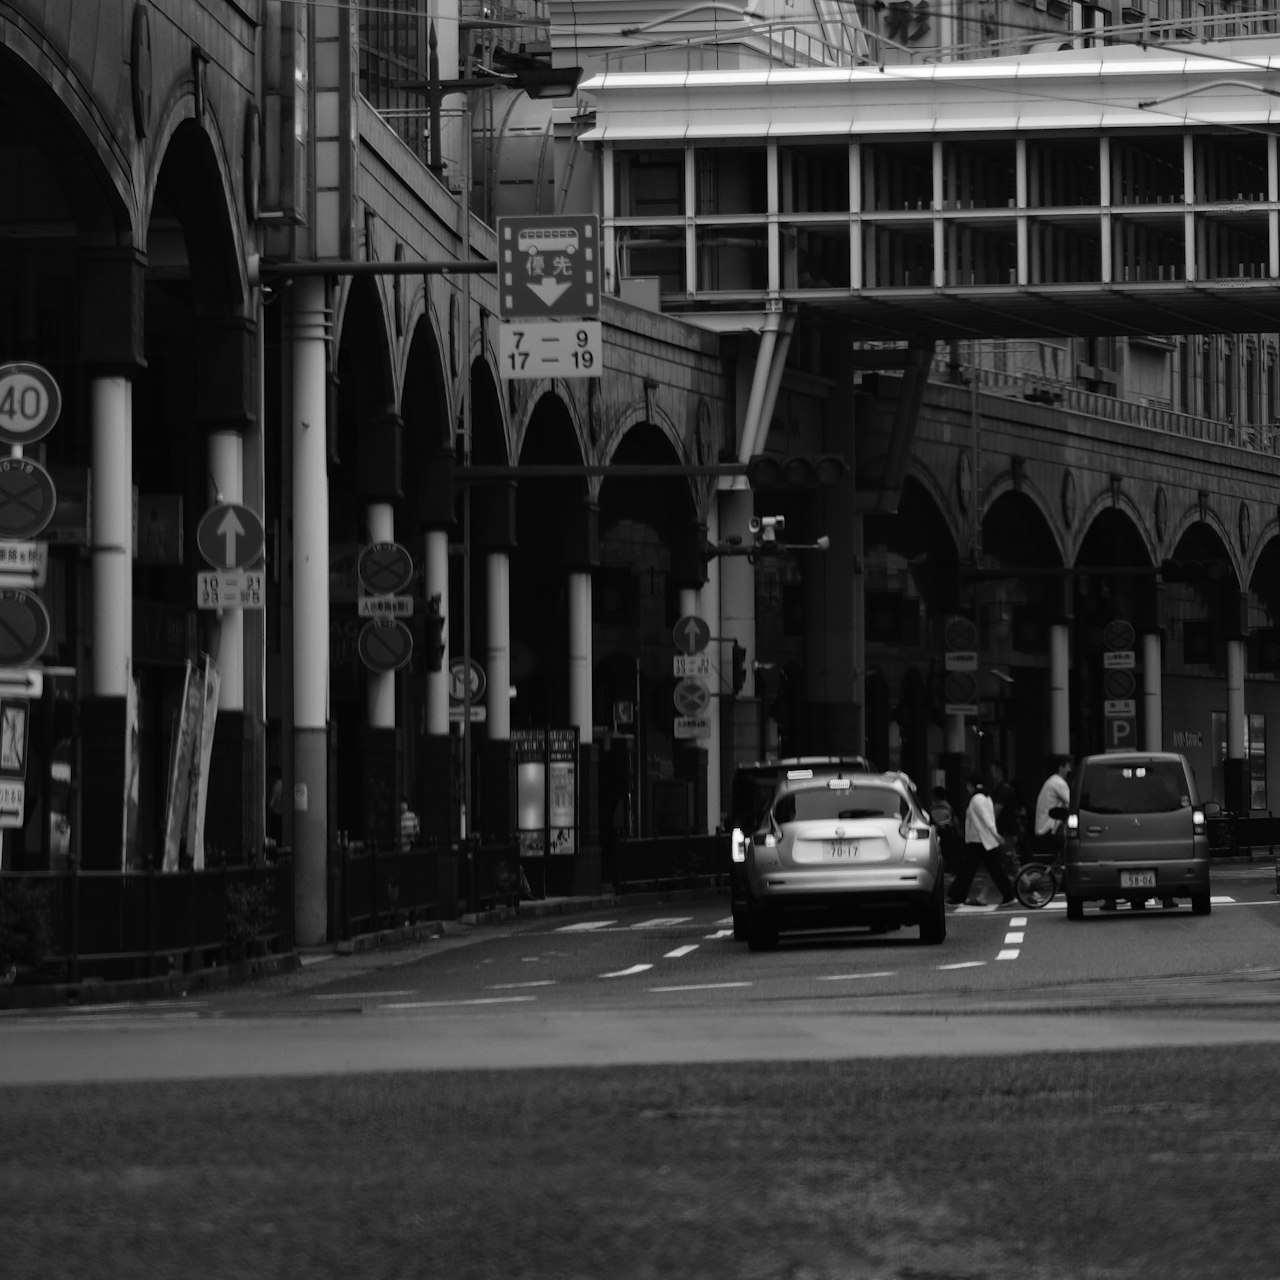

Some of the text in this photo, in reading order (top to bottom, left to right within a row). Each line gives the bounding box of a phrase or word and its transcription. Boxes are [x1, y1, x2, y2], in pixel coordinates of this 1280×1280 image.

[526, 255, 573, 276] 優先
[513, 331, 525, 350] 7
[576, 330, 589, 348] 9
[508, 352, 530, 370] 17
[571, 350, 593, 369] 19
[1113, 720, 1131, 745] P
